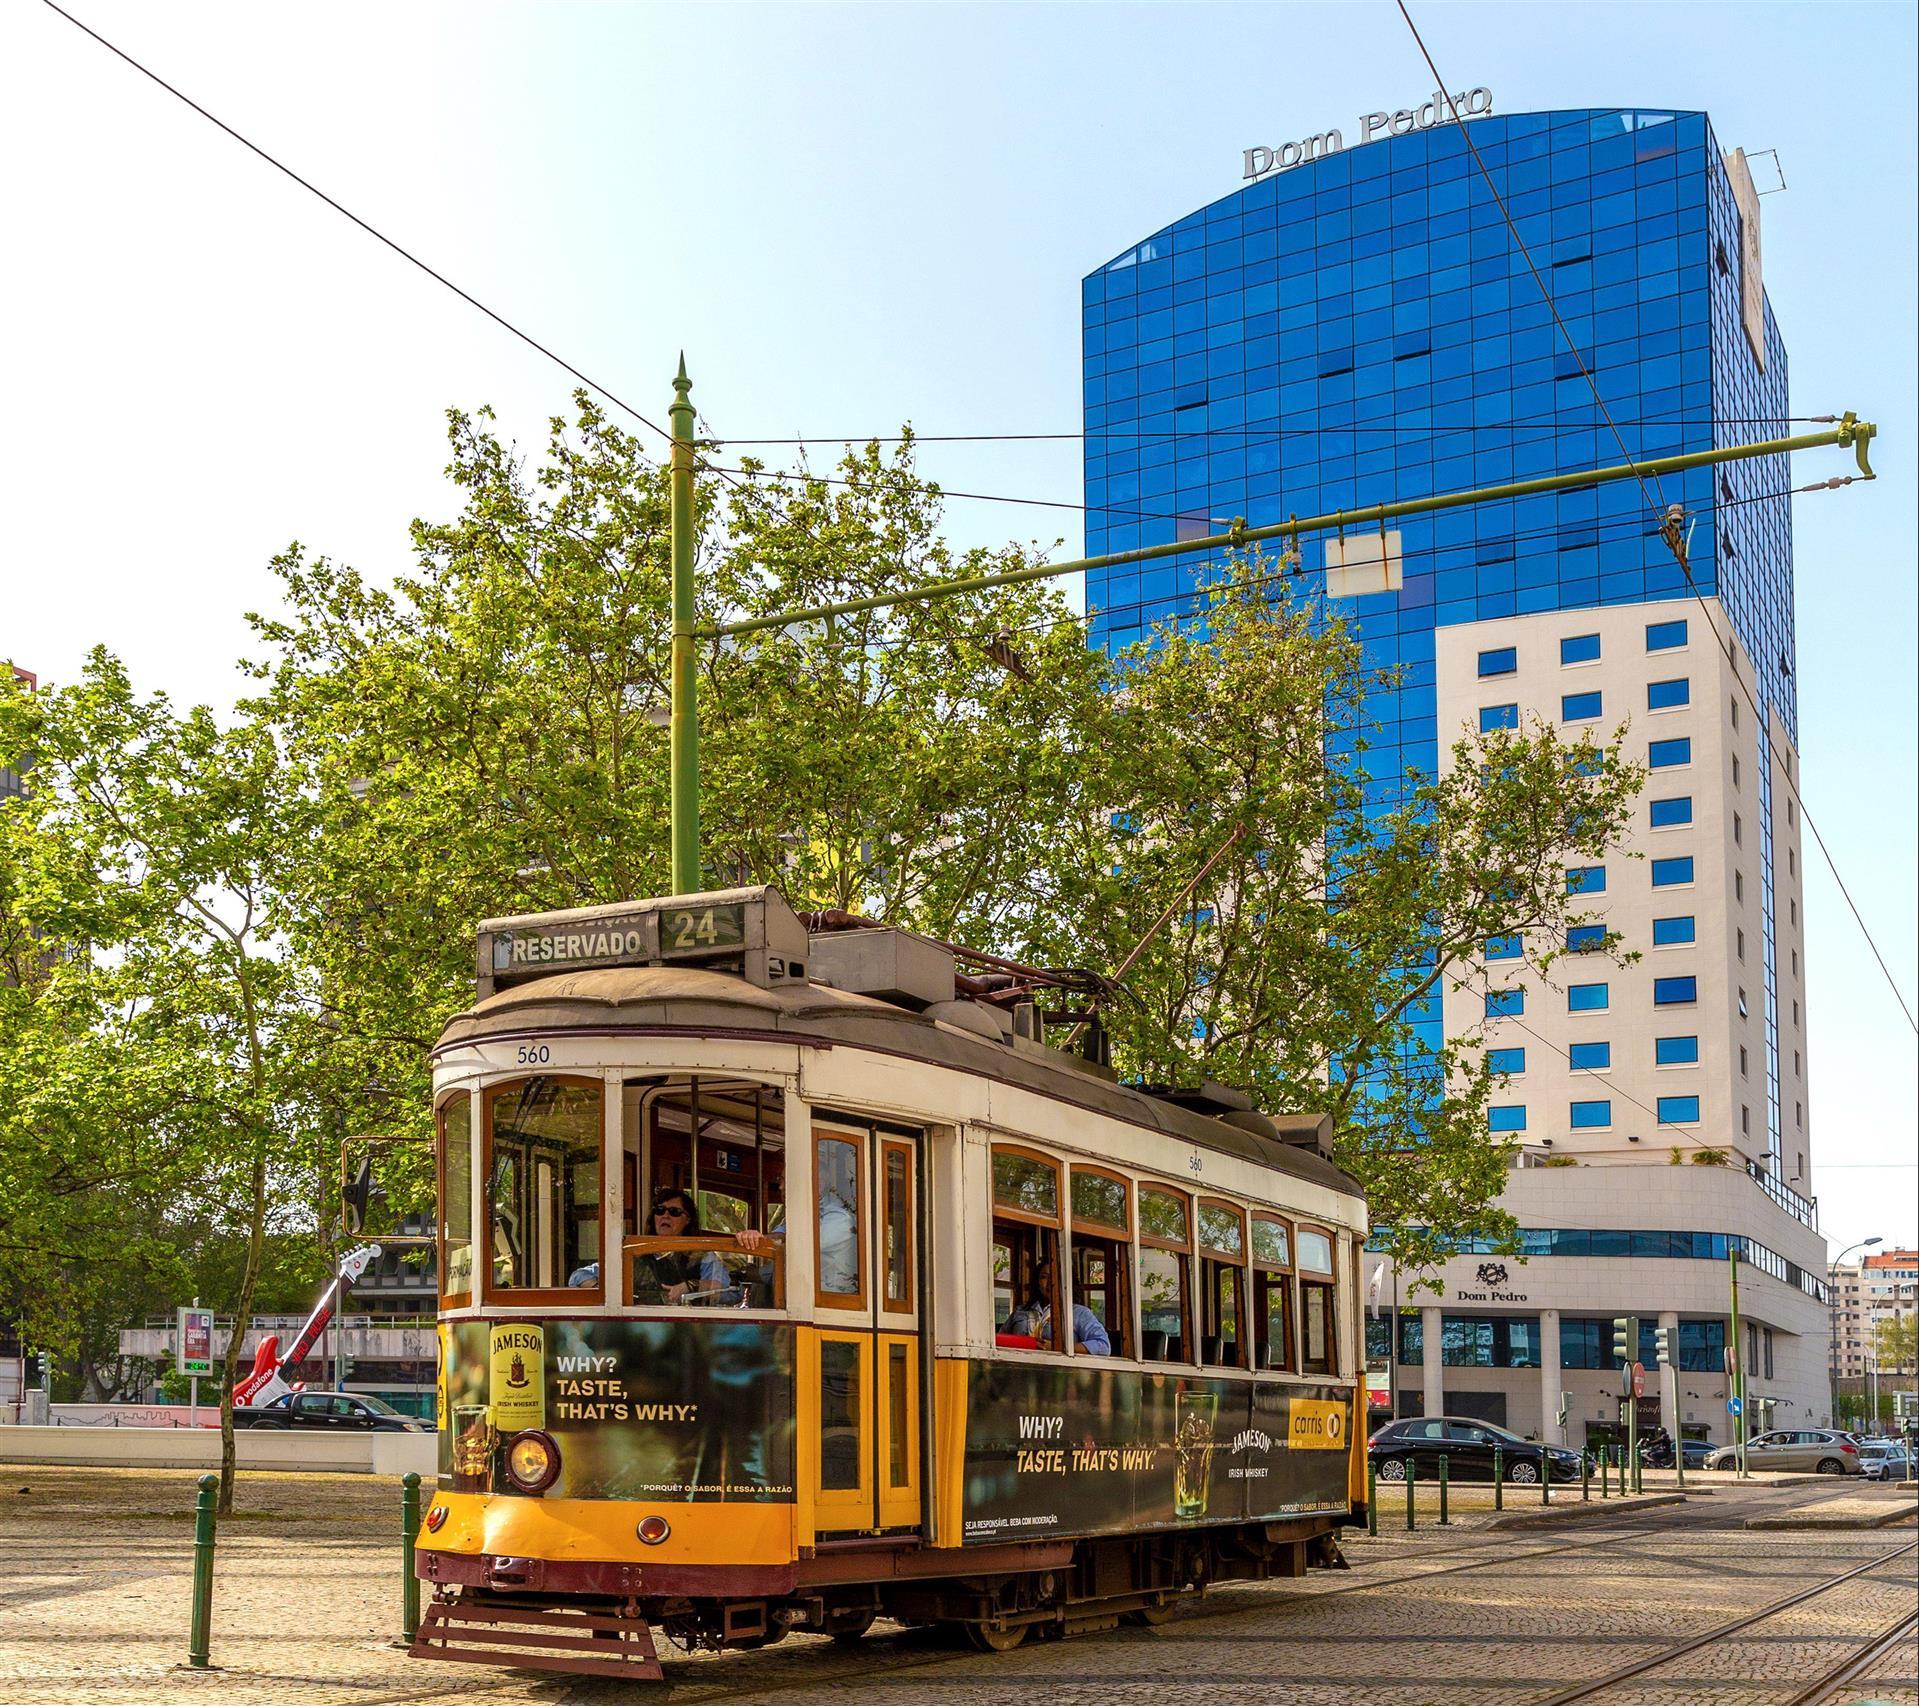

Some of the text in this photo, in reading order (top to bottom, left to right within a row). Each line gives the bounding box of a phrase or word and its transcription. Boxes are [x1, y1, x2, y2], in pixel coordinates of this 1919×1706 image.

[1242, 86, 1493, 180] Dom Pedro
[674, 910, 718, 949] 24
[513, 930, 641, 962] RESERVADO
[517, 1045, 550, 1064] 560
[1189, 1156, 1203, 1171] 560
[1457, 1291, 1528, 1302] Dom Pedro
[492, 1333, 542, 1355] JAMESON
[556, 1356, 617, 1373] WHY?
[243, 1367, 274, 1399] vodafone
[556, 1379, 628, 1400] TASTE,
[556, 1403, 629, 1420] THAT'S
[1019, 1416, 1064, 1439] WHY?
[1294, 1410, 1323, 1435] carris
[1231, 1429, 1271, 1455] JAMESON
[1017, 1450, 1067, 1476] TASTE,
[1072, 1450, 1119, 1472] THAT'S
[1228, 1468, 1269, 1478] IRISH WHISKEY
[726, 1484, 732, 1493] É
[765, 1485, 793, 1493] RAZÃO
[965, 1521, 978, 1530] SEJA
[1010, 1517, 1022, 1527] BEBA
[1022, 1516, 1032, 1526] COM
